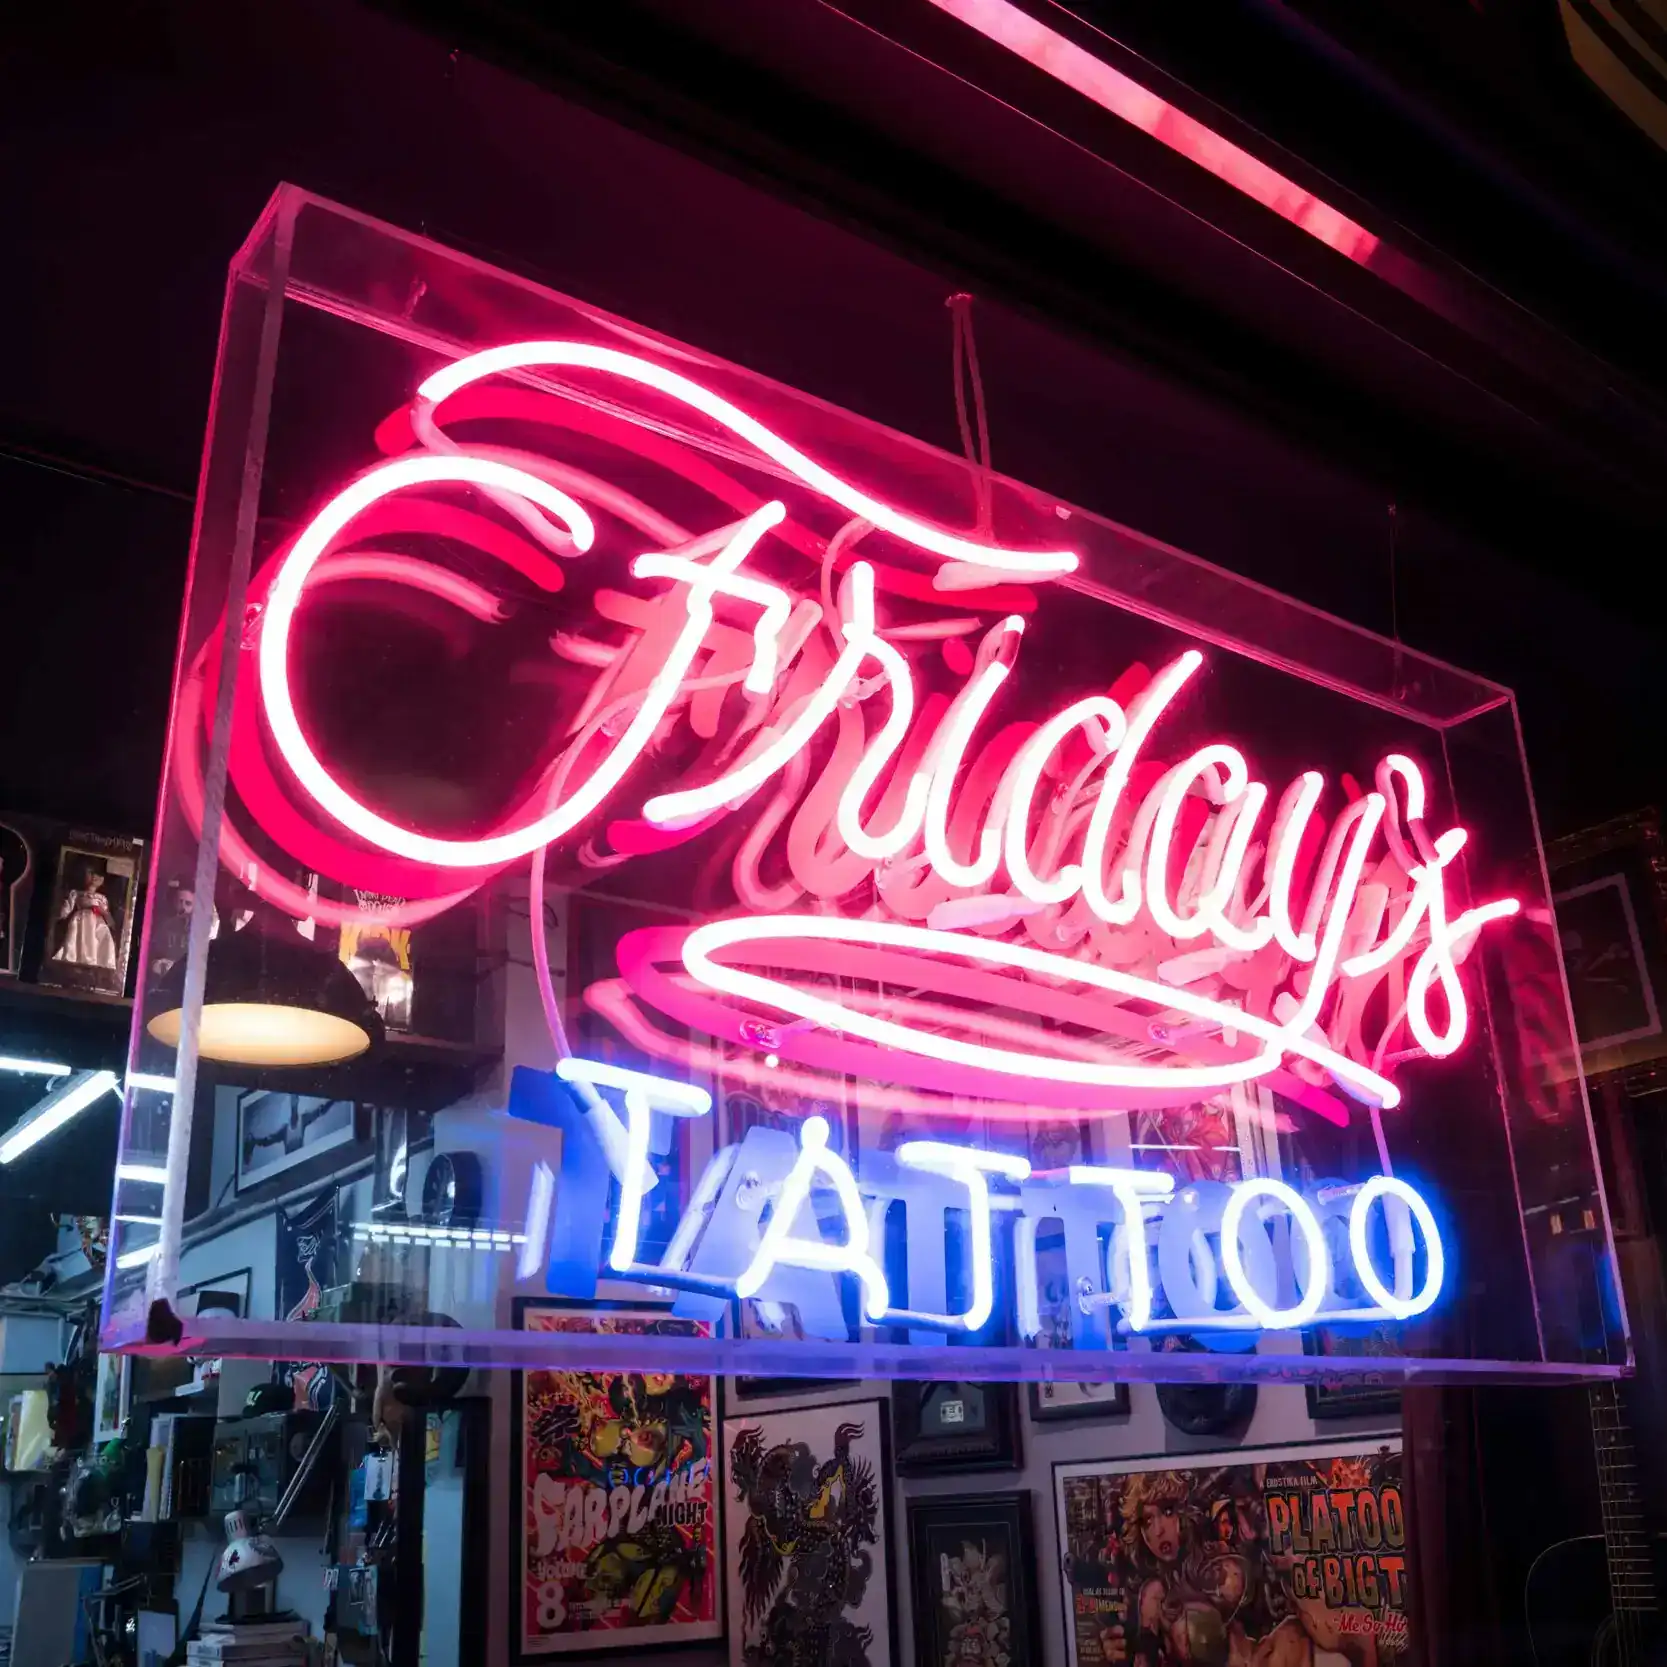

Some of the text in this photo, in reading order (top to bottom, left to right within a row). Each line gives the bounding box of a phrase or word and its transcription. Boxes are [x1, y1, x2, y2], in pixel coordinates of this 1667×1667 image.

[557, 1056, 1444, 1332] TATTOO
[655, 1501, 708, 1527] NIGHT
[537, 1580, 567, 1629] 8
